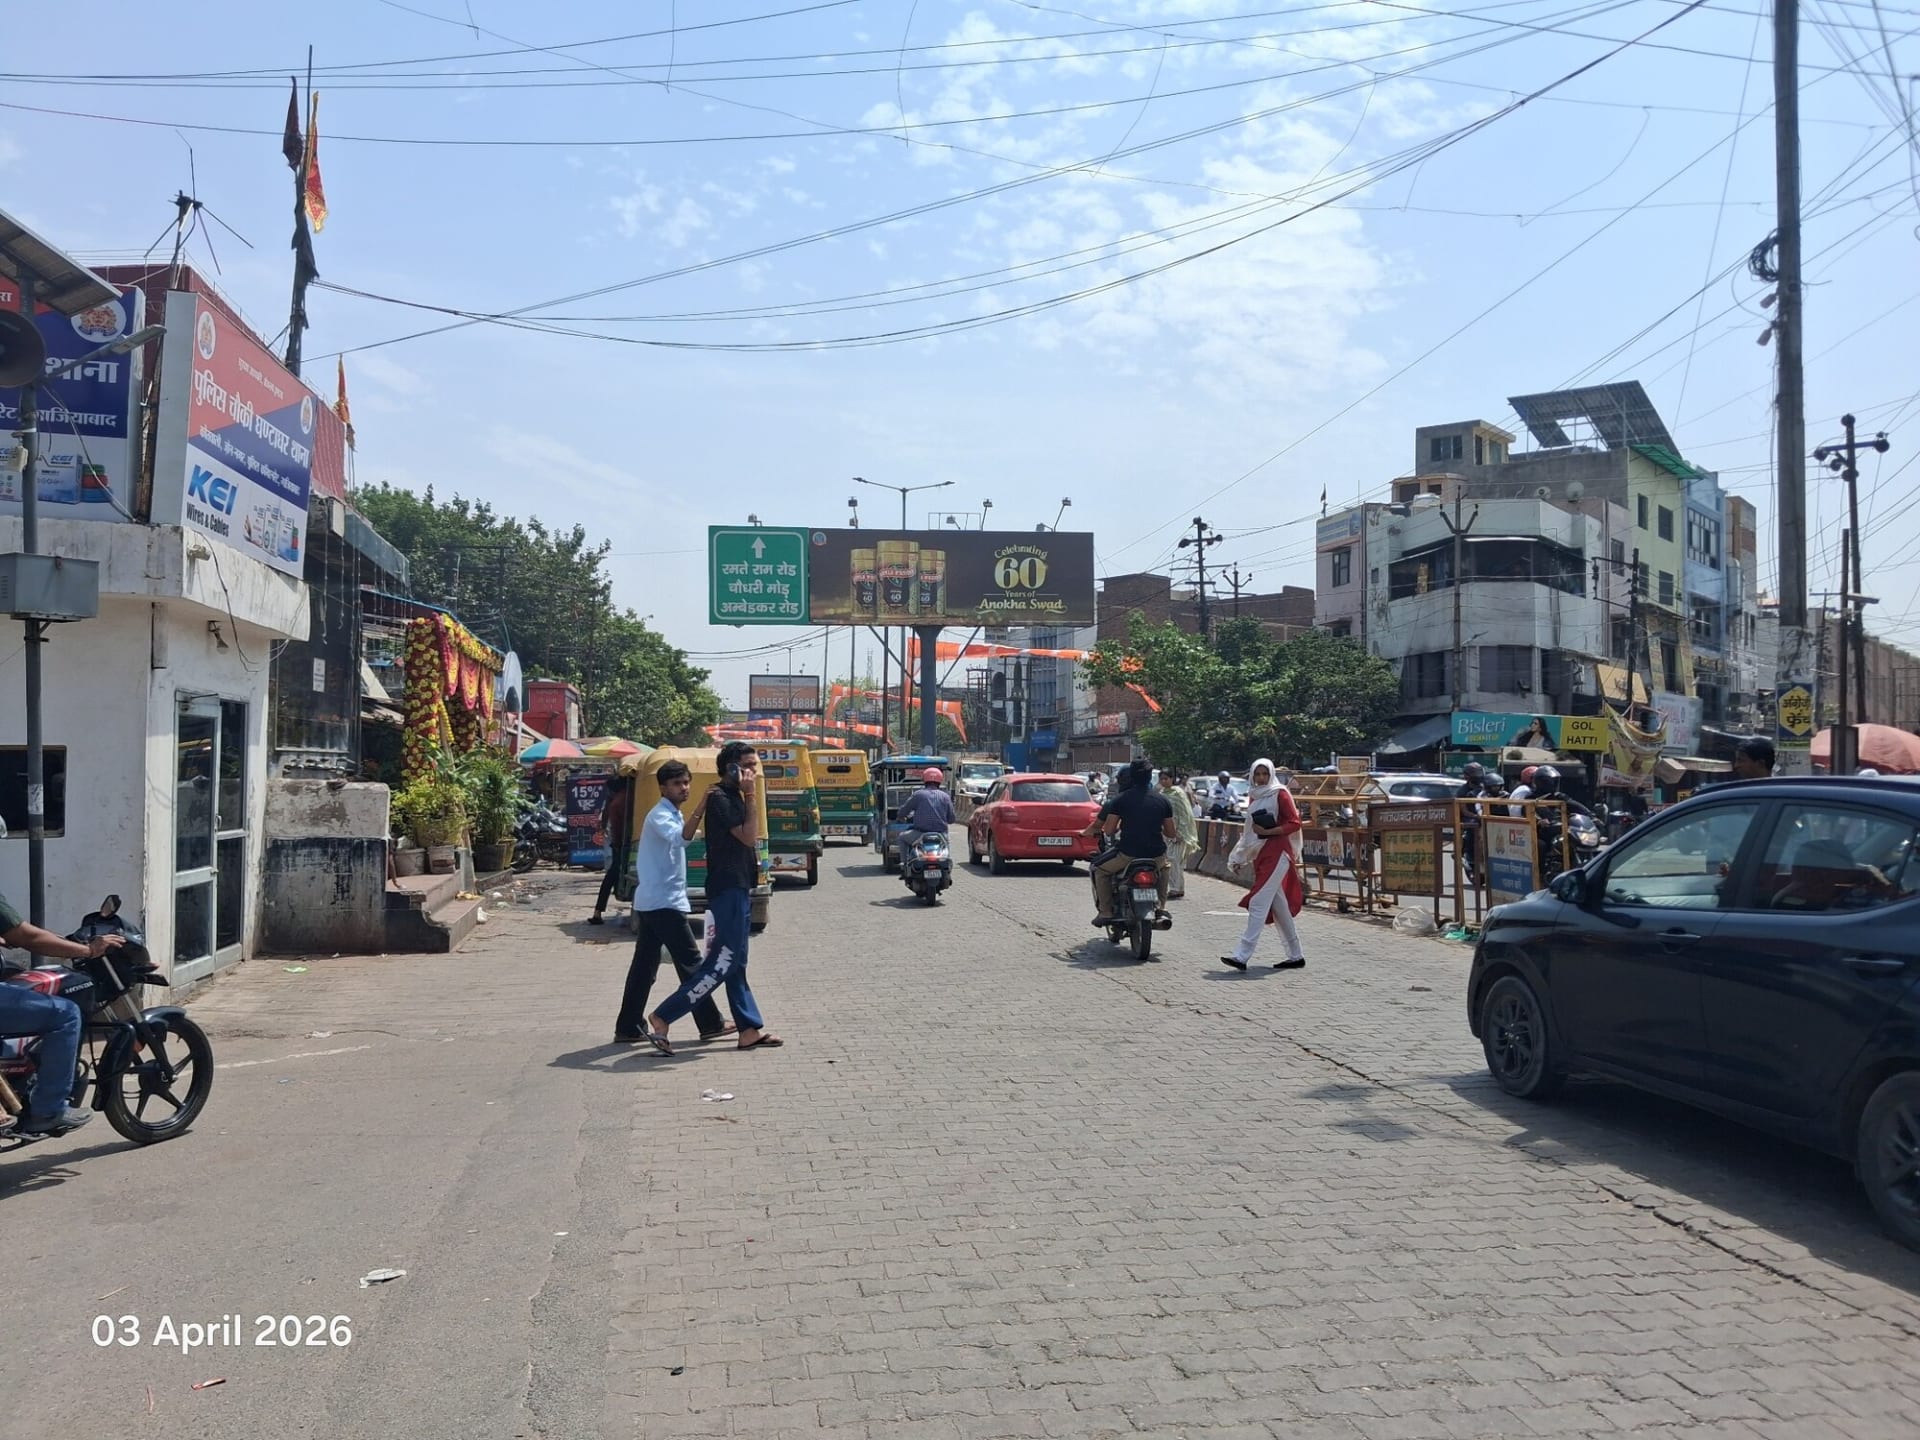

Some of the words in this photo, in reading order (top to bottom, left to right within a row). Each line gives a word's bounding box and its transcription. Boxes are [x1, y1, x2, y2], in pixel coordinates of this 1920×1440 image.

[194, 369, 227, 413] पुलिस
[229, 391, 254, 432] चौकी
[290, 439, 310, 469] थाना
[187, 464, 238, 516] KEI
[186, 502, 204, 527] Wires
[210, 513, 230, 538] Cables
[994, 544, 1048, 560] Celebrating
[721, 560, 749, 576] रमते
[751, 564, 774, 576] राम
[776, 560, 797, 577] रोड
[994, 557, 1047, 590] 60
[766, 579, 791, 600] मोड़
[1005, 590, 1026, 598] Years
[1027, 590, 1036, 598] of
[779, 600, 799, 615] रोड
[979, 598, 1027, 610] Anokha
[1029, 598, 1063, 610] Swad
[1458, 716, 1506, 734] Bisleri
[1571, 721, 1594, 731] GOL
[1566, 736, 1598, 745] HATTI
[64, 981, 94, 994] HONDA
